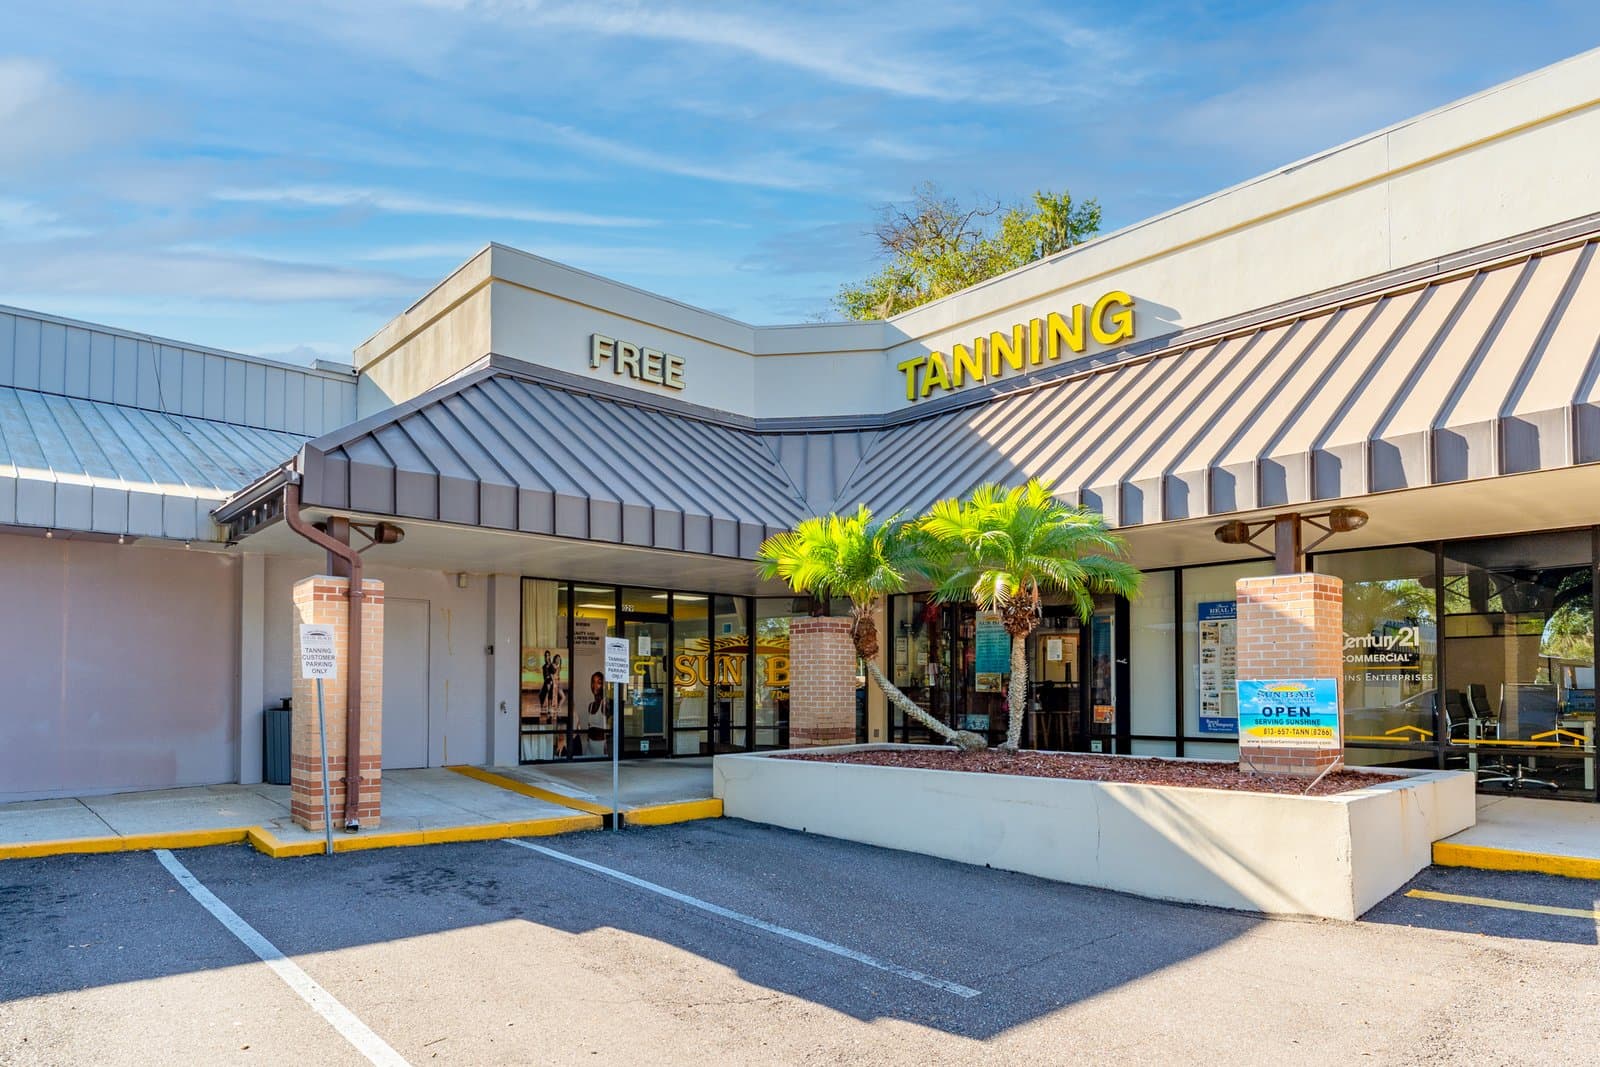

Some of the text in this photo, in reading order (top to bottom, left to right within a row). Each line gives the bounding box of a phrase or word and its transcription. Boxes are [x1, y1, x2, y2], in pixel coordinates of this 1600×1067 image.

[897, 290, 1136, 402] TANNING
[589, 333, 686, 391] FREE
[1398, 626, 1420, 647] 21
[673, 654, 745, 687] SUN
[1365, 672, 1434, 681] ENTERPRISES
[1262, 706, 1311, 718] OPEN
[1286, 719, 1321, 727] SUNSHINE
